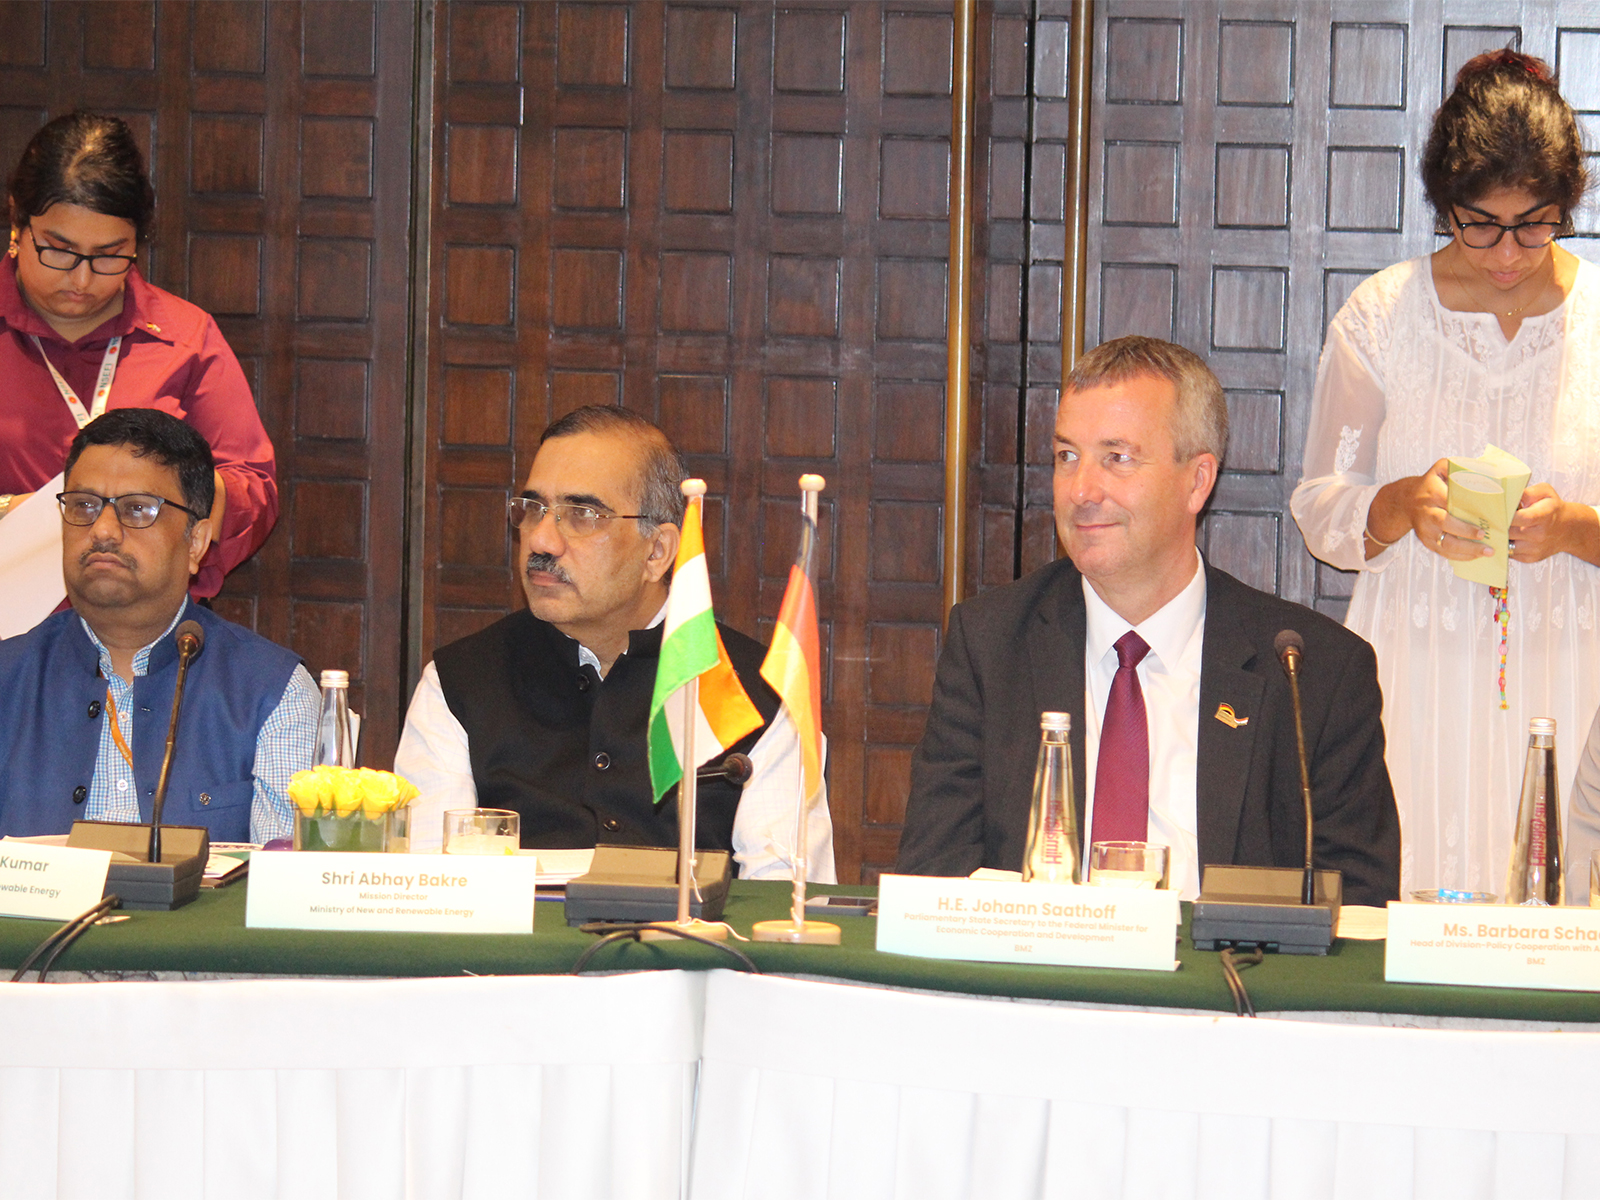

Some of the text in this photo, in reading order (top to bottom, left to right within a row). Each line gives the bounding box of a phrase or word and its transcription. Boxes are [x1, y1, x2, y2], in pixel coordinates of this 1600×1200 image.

[0, 856, 49, 872] Kumar
[321, 871, 468, 891] Shri Abhay Bakre
[29, 885, 61, 898] Energy
[359, 892, 428, 901] Mission Director
[309, 906, 345, 915] Ministry
[346, 906, 356, 914] of
[395, 907, 443, 916] Renewable
[444, 908, 474, 918] Energy
[938, 897, 1117, 919] H.E. Johann Saathoff
[904, 912, 967, 925] Parliamentary
[968, 916, 992, 925] State
[993, 917, 1036, 928] Secretary
[1048, 920, 1063, 928] the
[1064, 921, 1097, 930] Federal
[1098, 923, 1134, 932] Minister
[936, 925, 1115, 943] Economic Cooperation and Development
[1443, 923, 1473, 937] Ms.
[1477, 924, 1549, 939] Barbara
[1014, 944, 1033, 953] BMZ
[1410, 939, 1434, 947] Head
[1435, 939, 1445, 947] of
[1446, 940, 1513, 951] Division-Policy
[1514, 942, 1571, 952] Cooperation
[1572, 943, 1592, 952] with
[1526, 957, 1546, 965] BMZ
